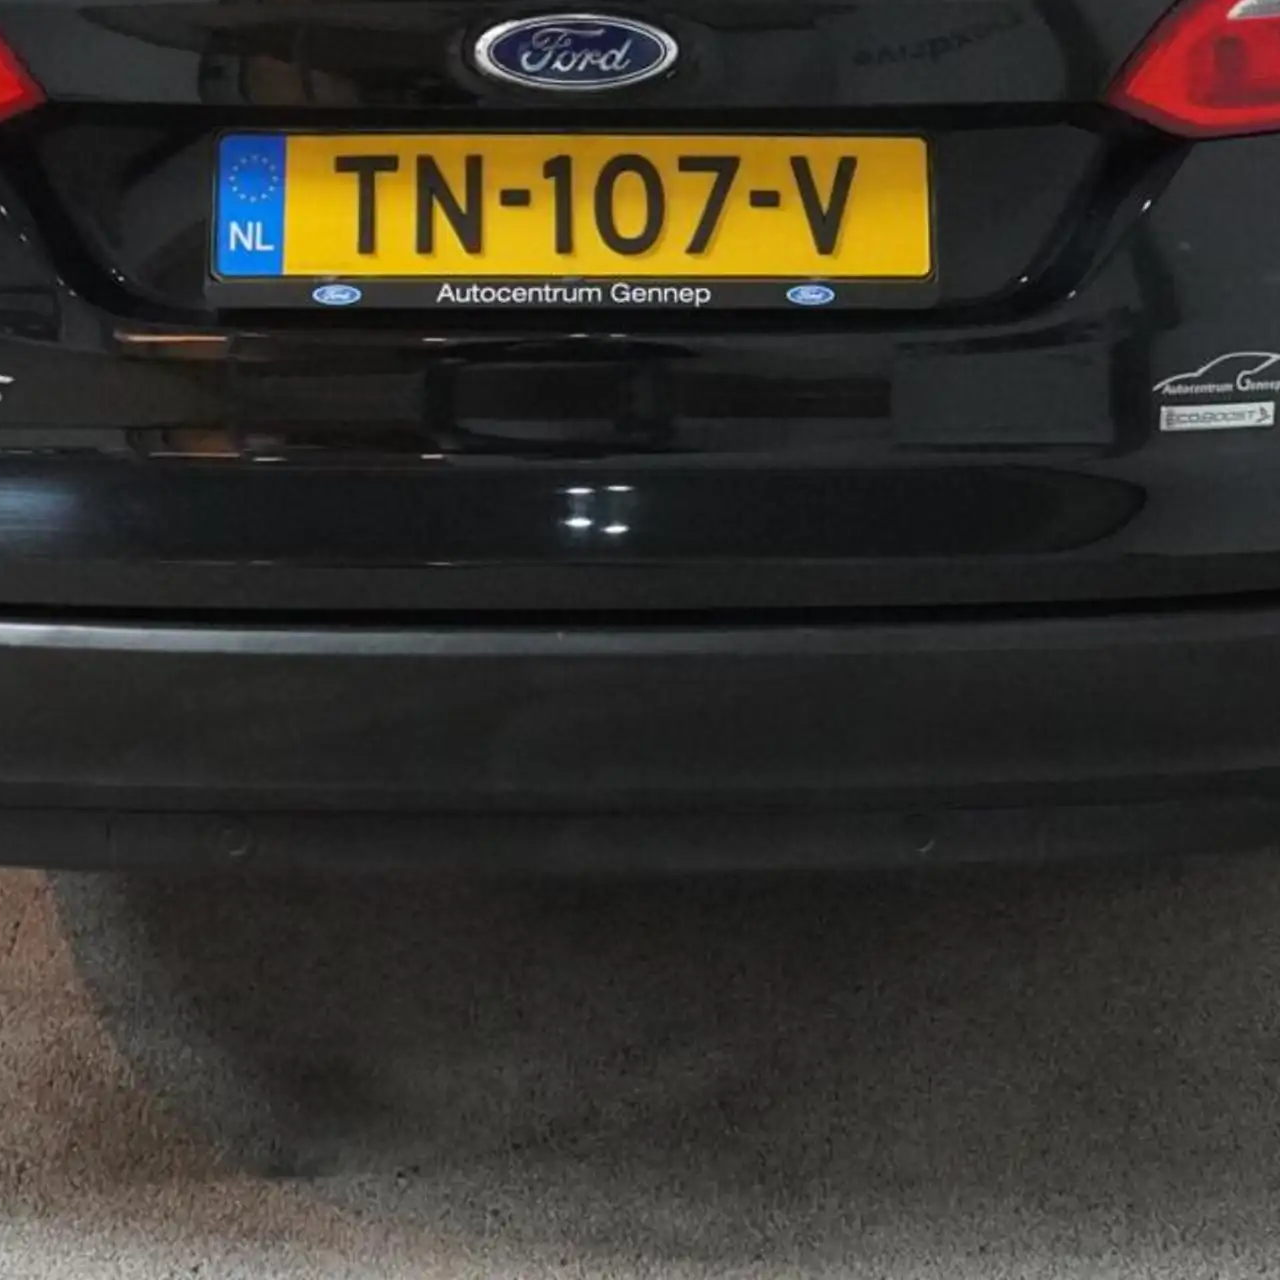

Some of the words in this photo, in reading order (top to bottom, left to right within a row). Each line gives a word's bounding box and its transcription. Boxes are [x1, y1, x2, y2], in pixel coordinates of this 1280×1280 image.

[520, 27, 632, 72] Ford
[334, 154, 858, 256] TN-107-V
[229, 221, 275, 251] NL
[436, 283, 602, 304] Autocentrum
[610, 283, 711, 307] Gennep
[1162, 382, 1233, 395] Autocentrum
